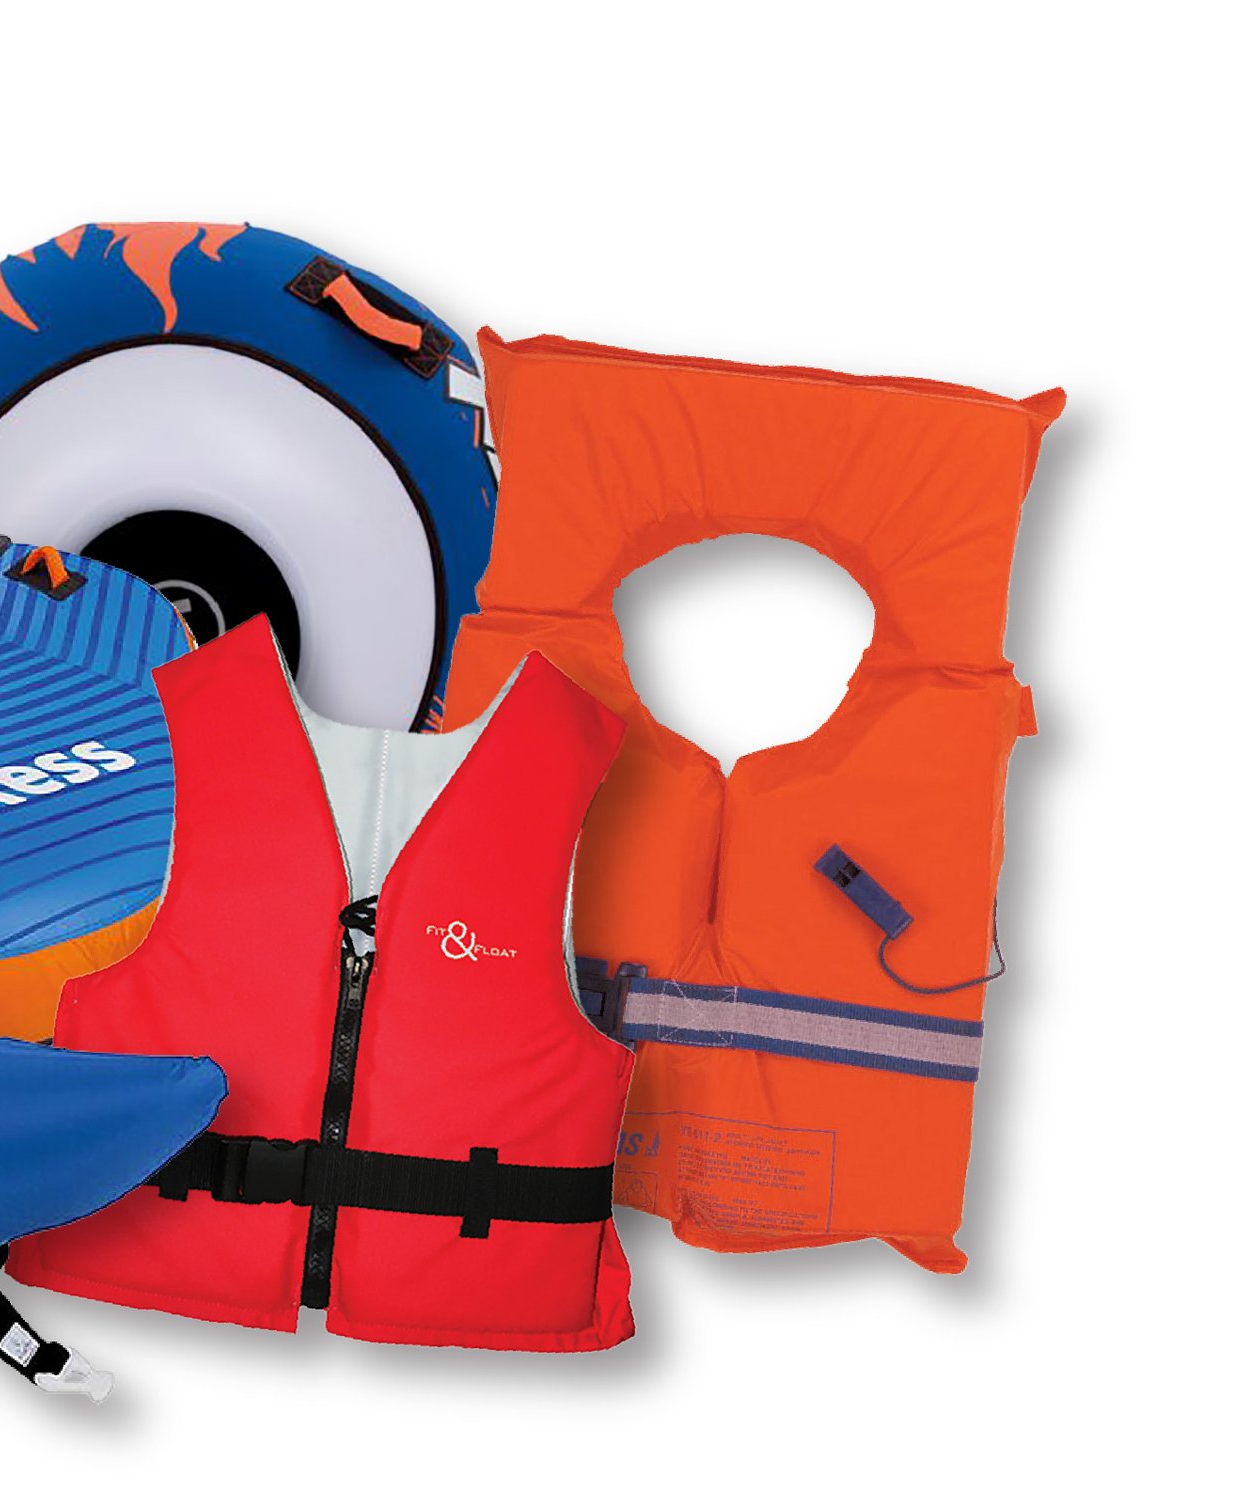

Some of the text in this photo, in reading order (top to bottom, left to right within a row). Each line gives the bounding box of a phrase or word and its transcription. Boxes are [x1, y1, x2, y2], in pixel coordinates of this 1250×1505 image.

[426, 920, 517, 961] FIT & FLOAT
